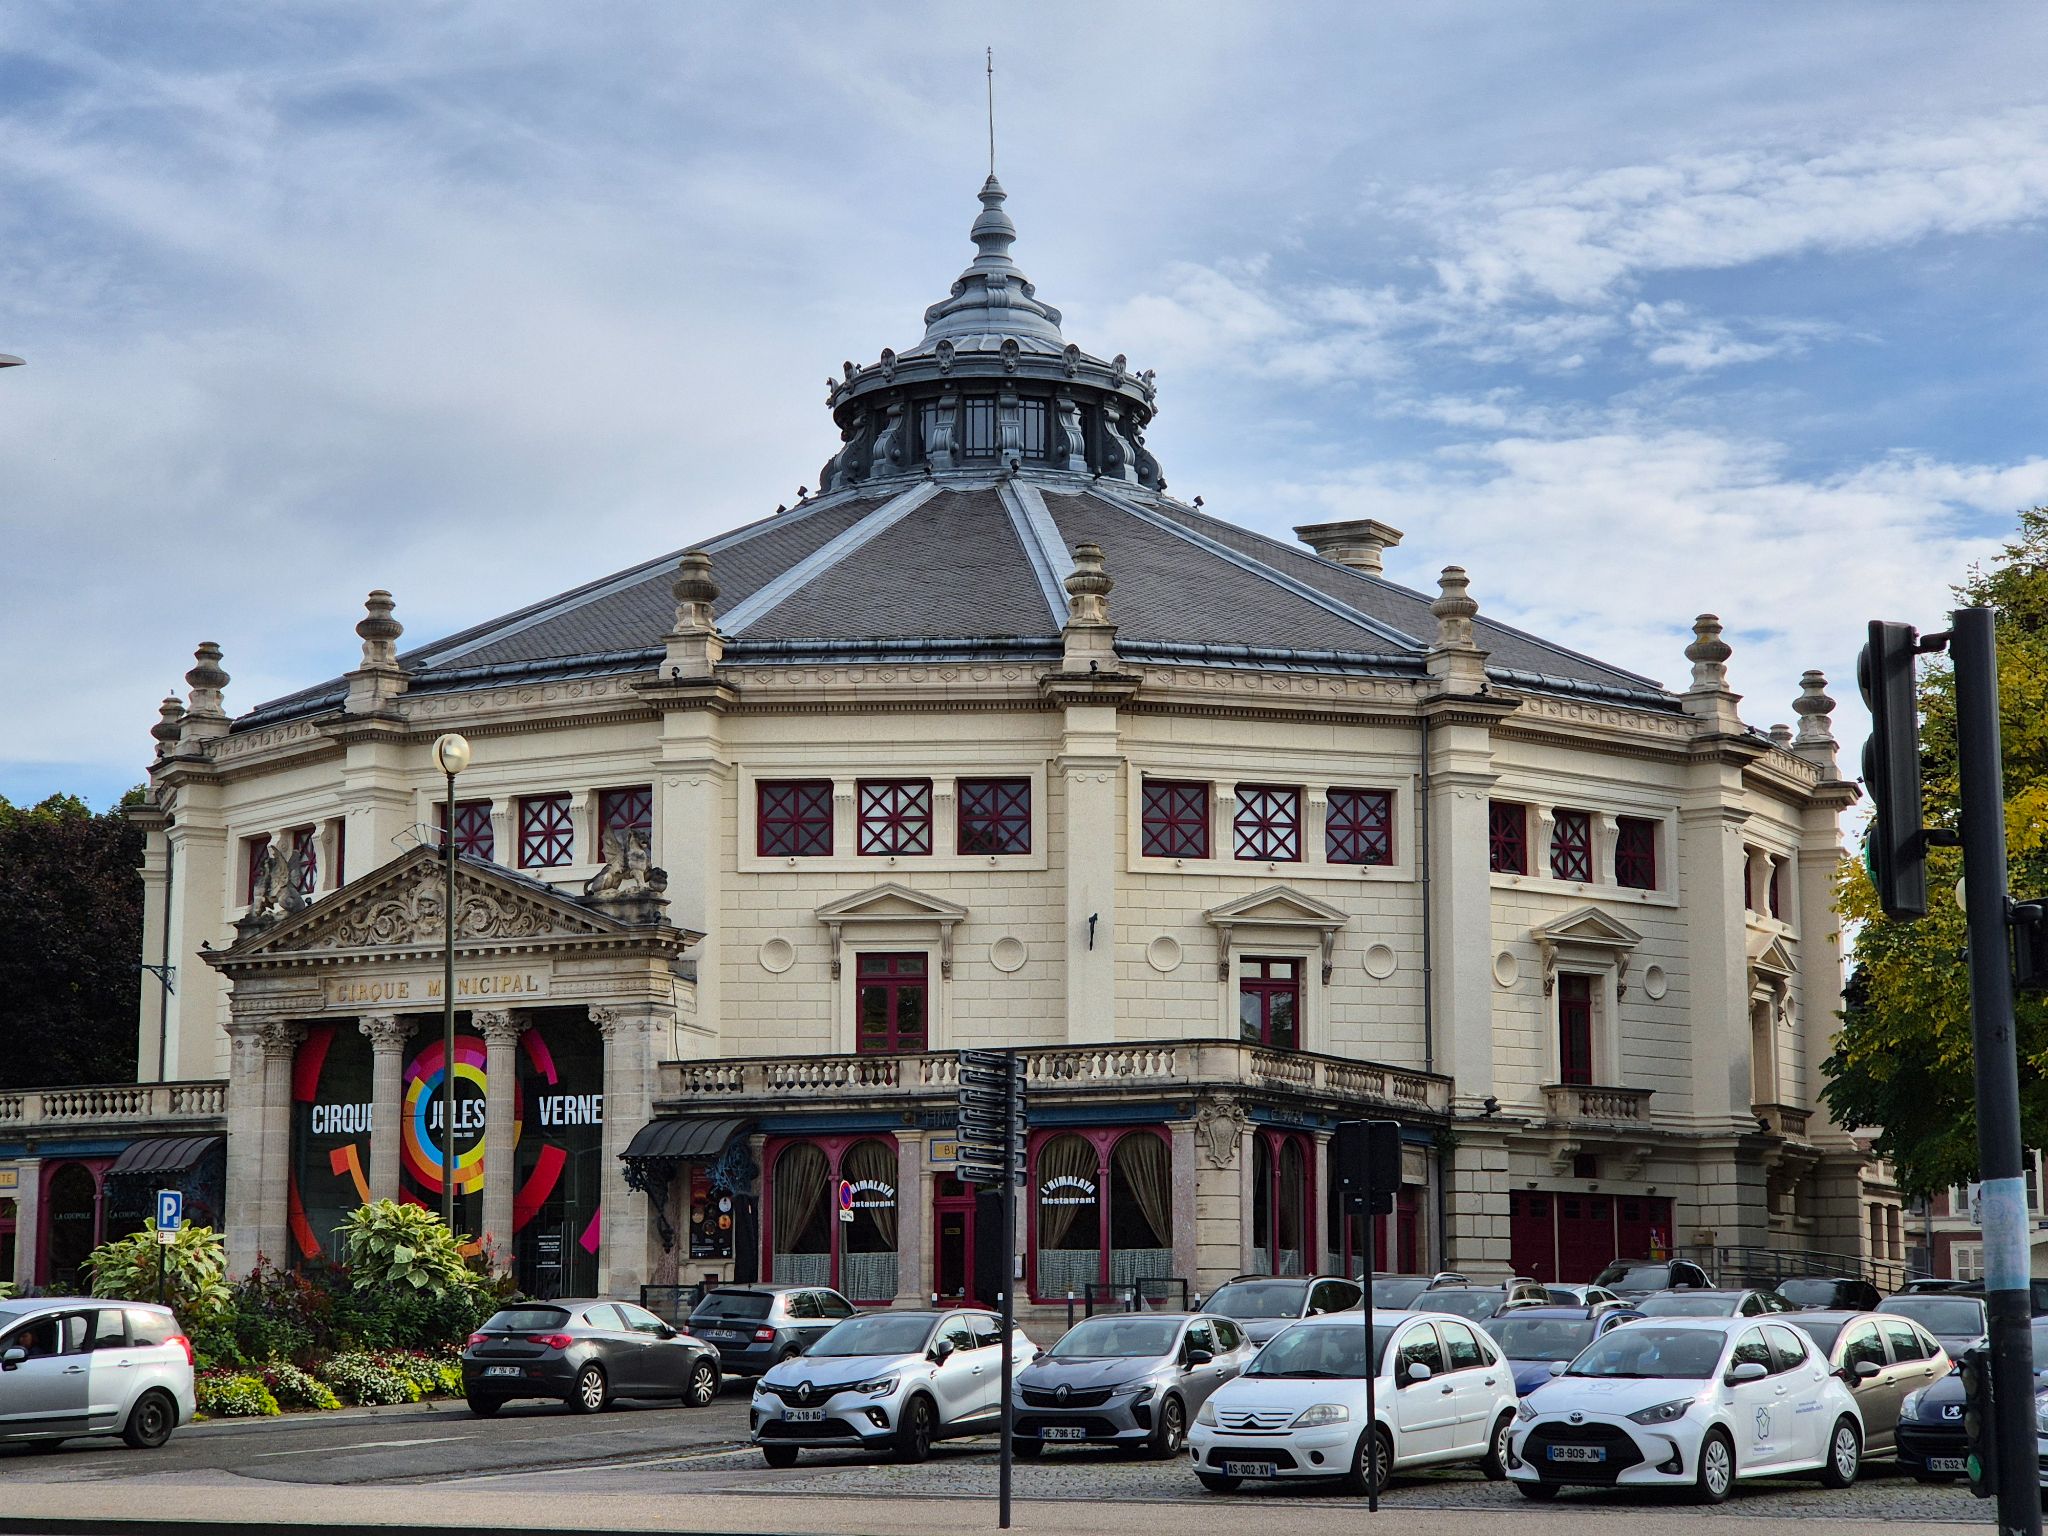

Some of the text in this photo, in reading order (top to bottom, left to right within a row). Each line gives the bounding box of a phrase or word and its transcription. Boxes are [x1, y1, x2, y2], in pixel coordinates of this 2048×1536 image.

[336, 974, 538, 1002] CIRQUE MNICIPAL
[539, 1094, 604, 1126] VERNE
[1040, 1175, 1095, 1195] L'HIMALAYA
[850, 1200, 895, 1208] estaurant
[1041, 1196, 1096, 1205] Restaurant
[1042, 1428, 1081, 1439] HE-796-EZ
[1553, 1447, 1600, 1459] GB-909-JN
[1228, 1463, 1269, 1476] AS-002-XV
